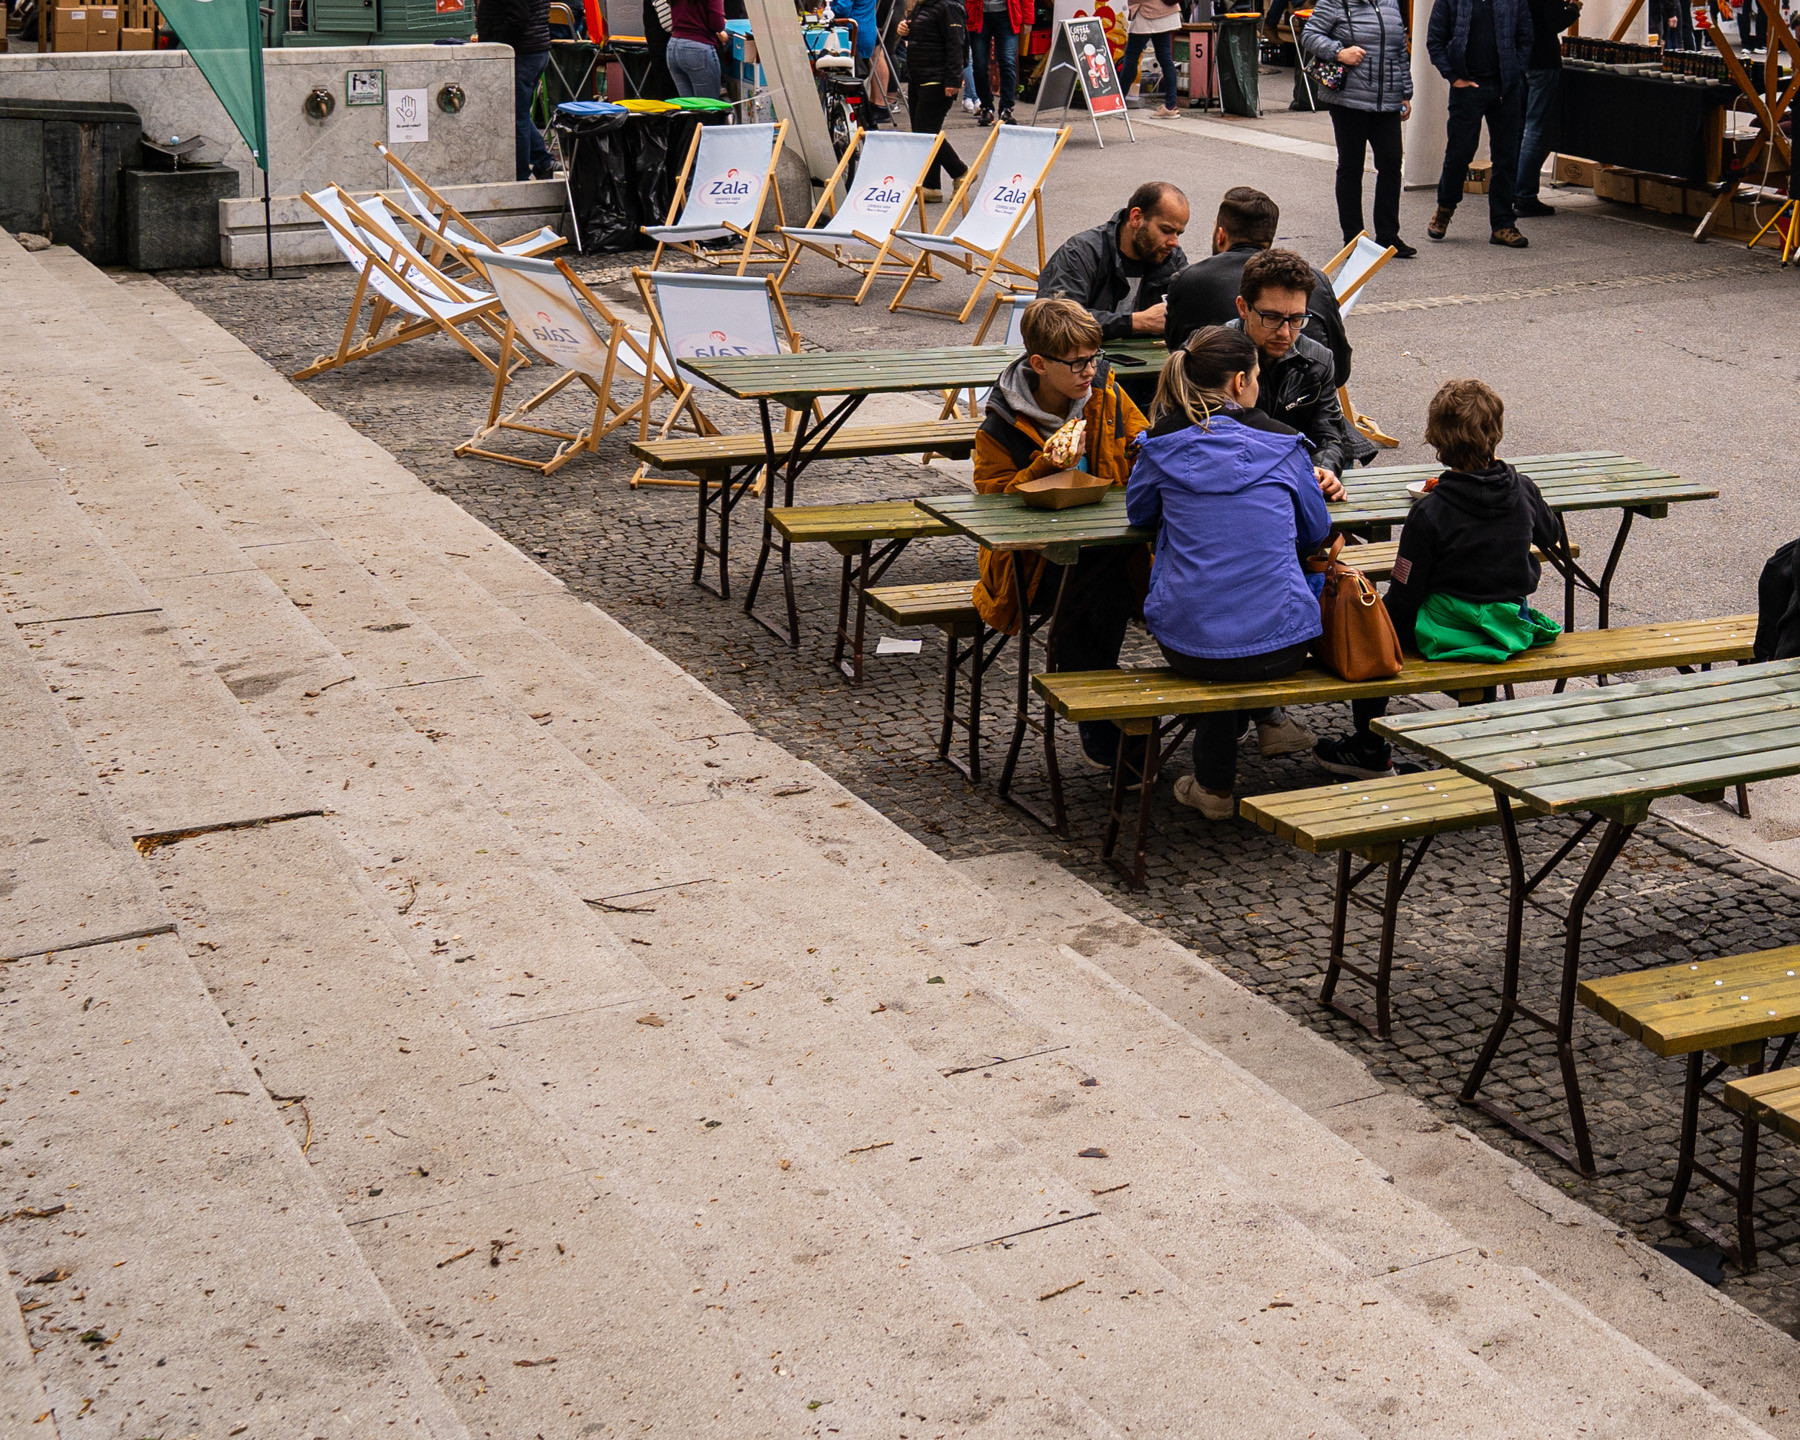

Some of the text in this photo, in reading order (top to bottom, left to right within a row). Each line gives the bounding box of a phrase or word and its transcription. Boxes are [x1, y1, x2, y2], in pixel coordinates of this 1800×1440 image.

[1069, 24, 1091, 35] COFFEE
[1195, 43, 1203, 59] 5
[709, 180, 749, 195] Zala
[863, 187, 901, 203] Zala
[993, 186, 1027, 204] Zala
